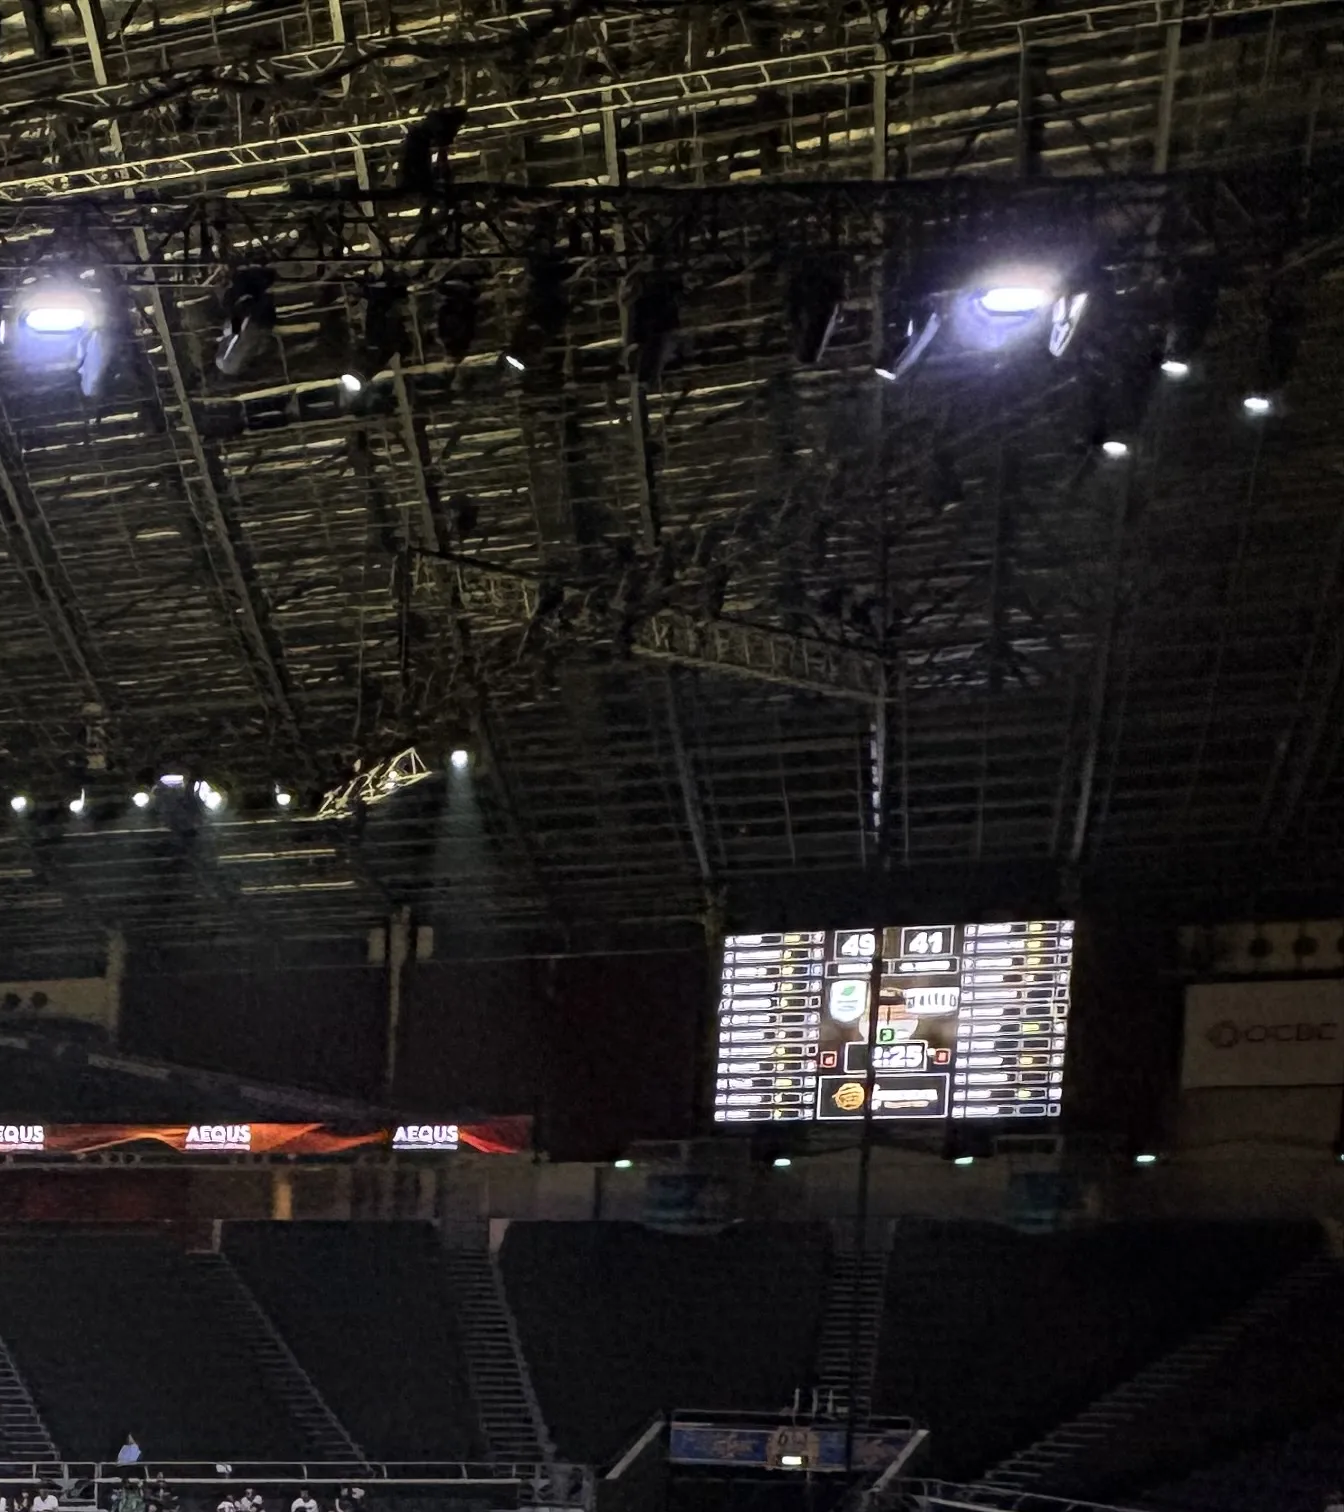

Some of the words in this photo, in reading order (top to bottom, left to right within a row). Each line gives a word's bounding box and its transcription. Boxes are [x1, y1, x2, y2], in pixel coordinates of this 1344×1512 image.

[841, 933, 875, 956] 49
[909, 931, 943, 954] 41
[186, 1125, 251, 1143] AEQUS
[393, 1125, 458, 1143] AEQUS
